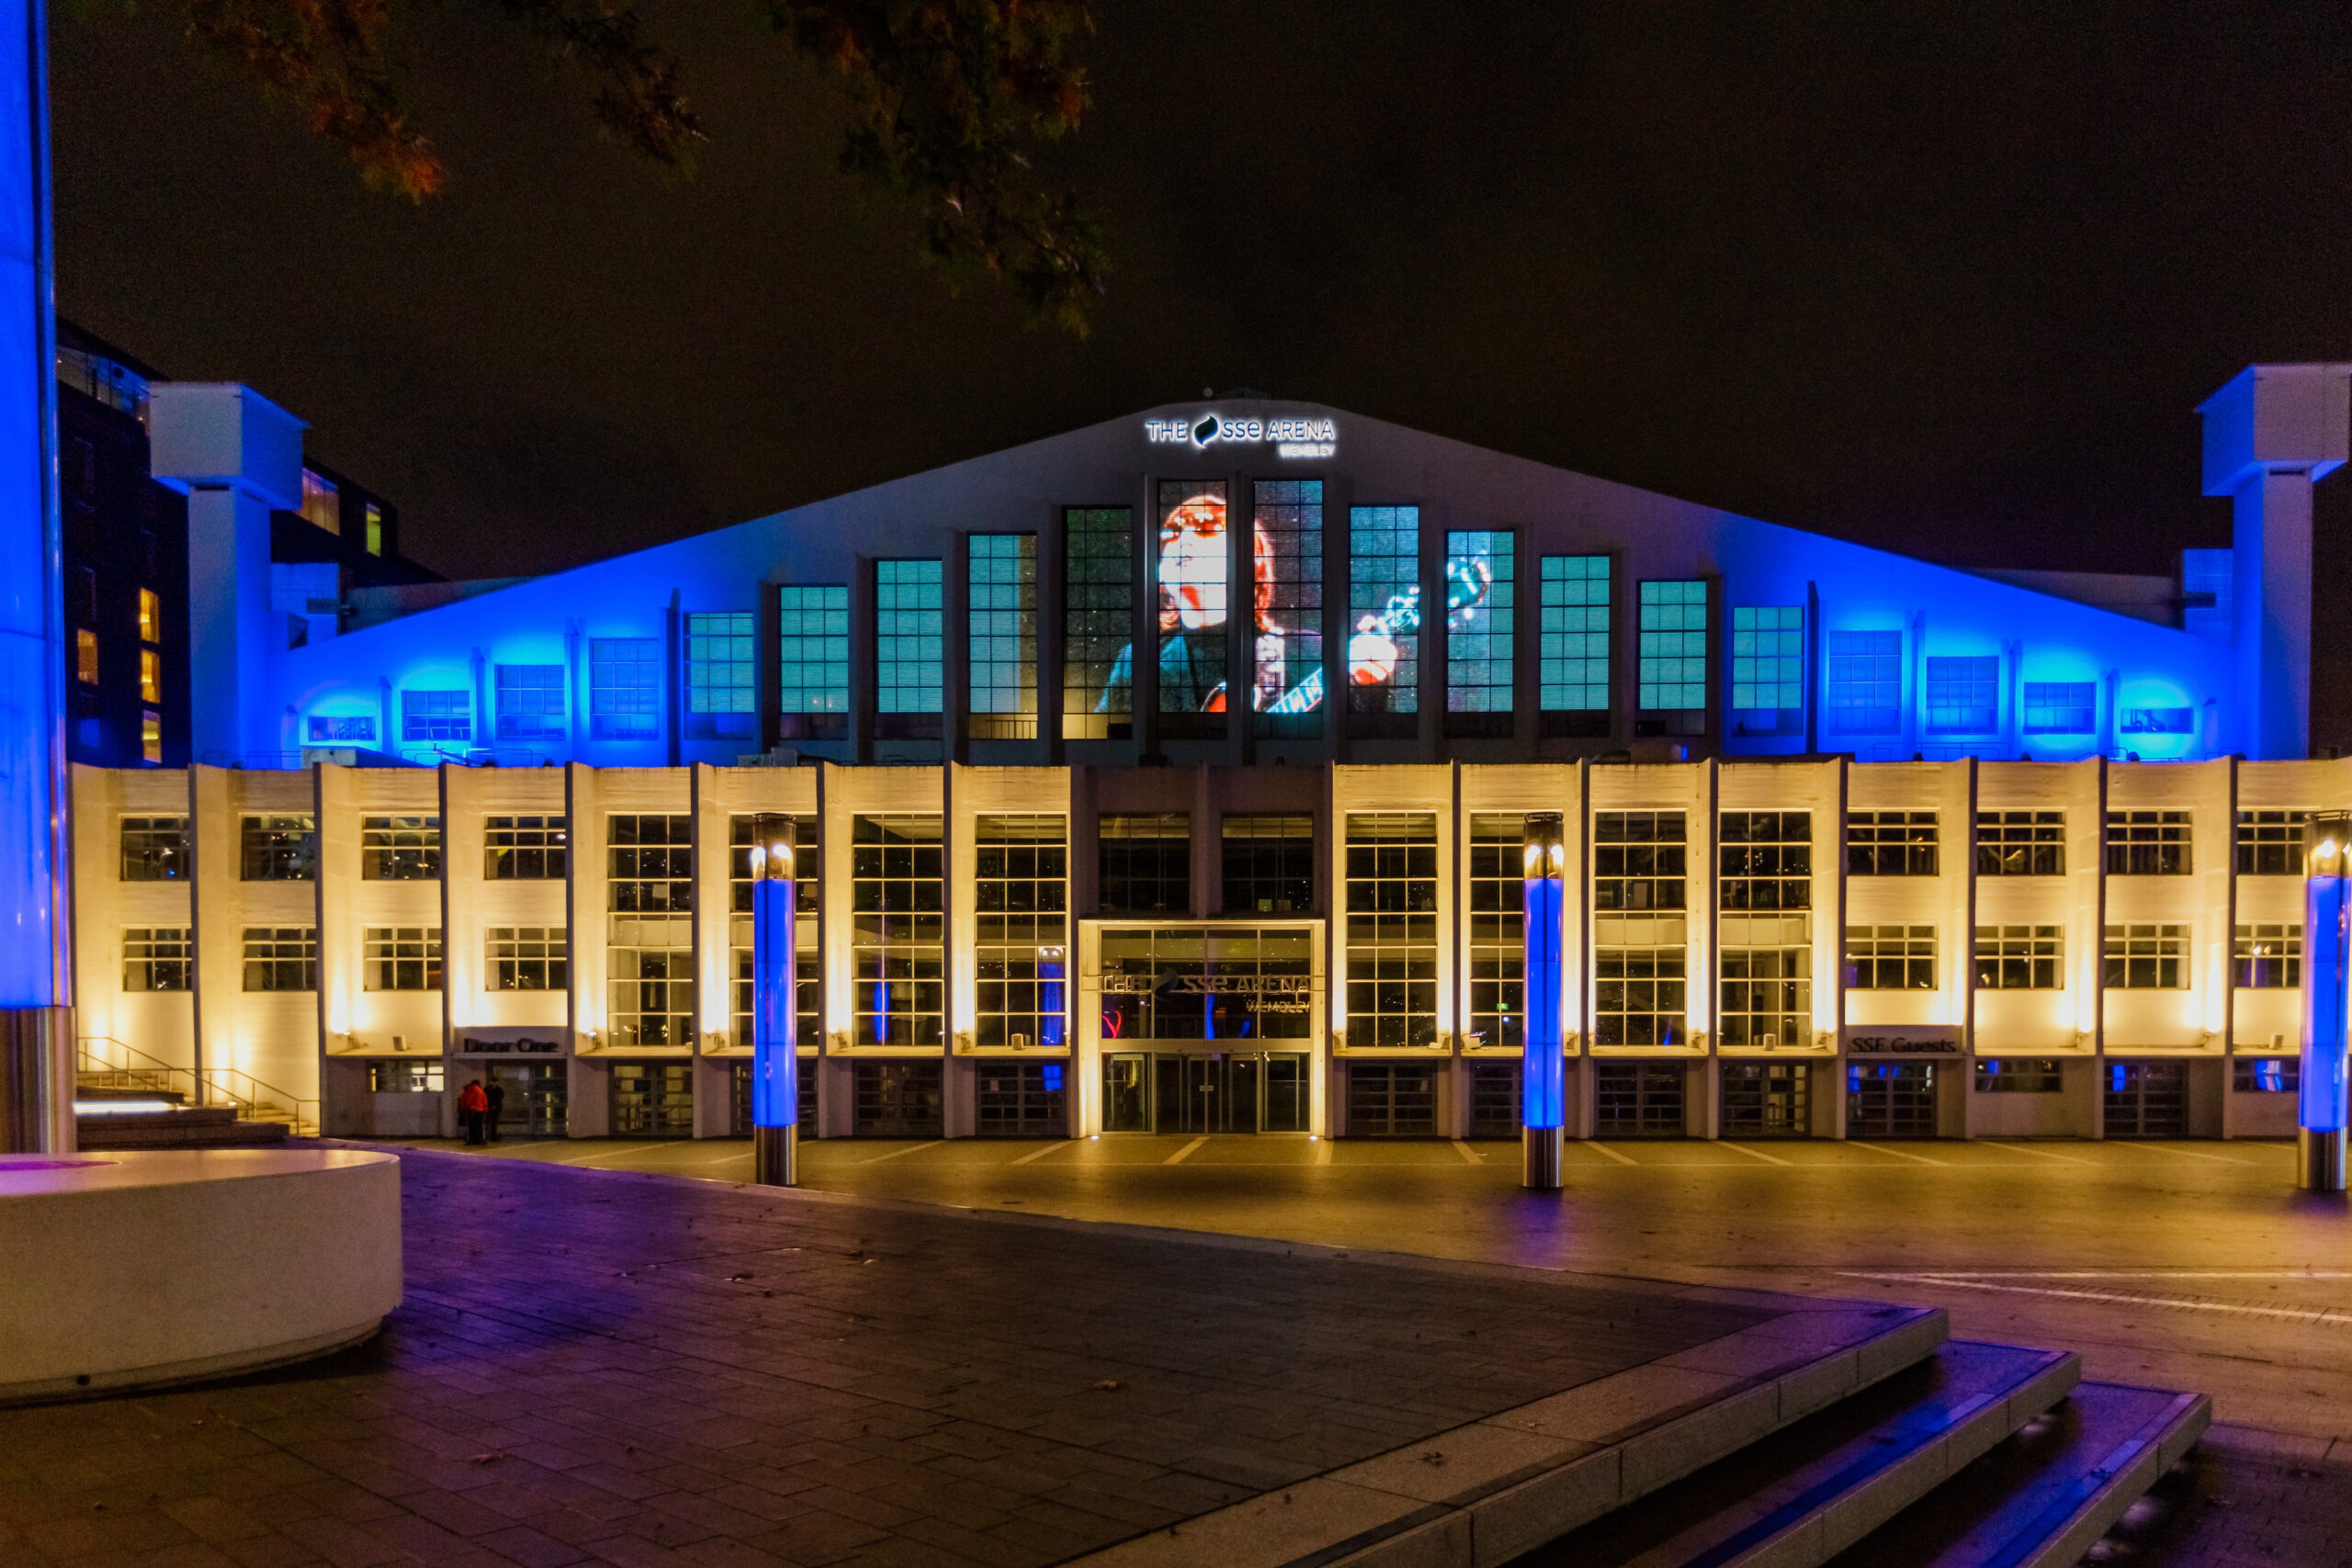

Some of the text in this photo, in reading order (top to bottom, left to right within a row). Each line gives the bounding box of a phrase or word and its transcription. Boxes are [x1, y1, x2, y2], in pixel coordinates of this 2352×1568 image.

[1145, 420, 1187, 441] THE
[1267, 420, 1335, 441] ARENA
[1236, 975, 1311, 993] ARENA
[463, 1038, 560, 1053] Door One
[1890, 1037, 1956, 1053] Guests
